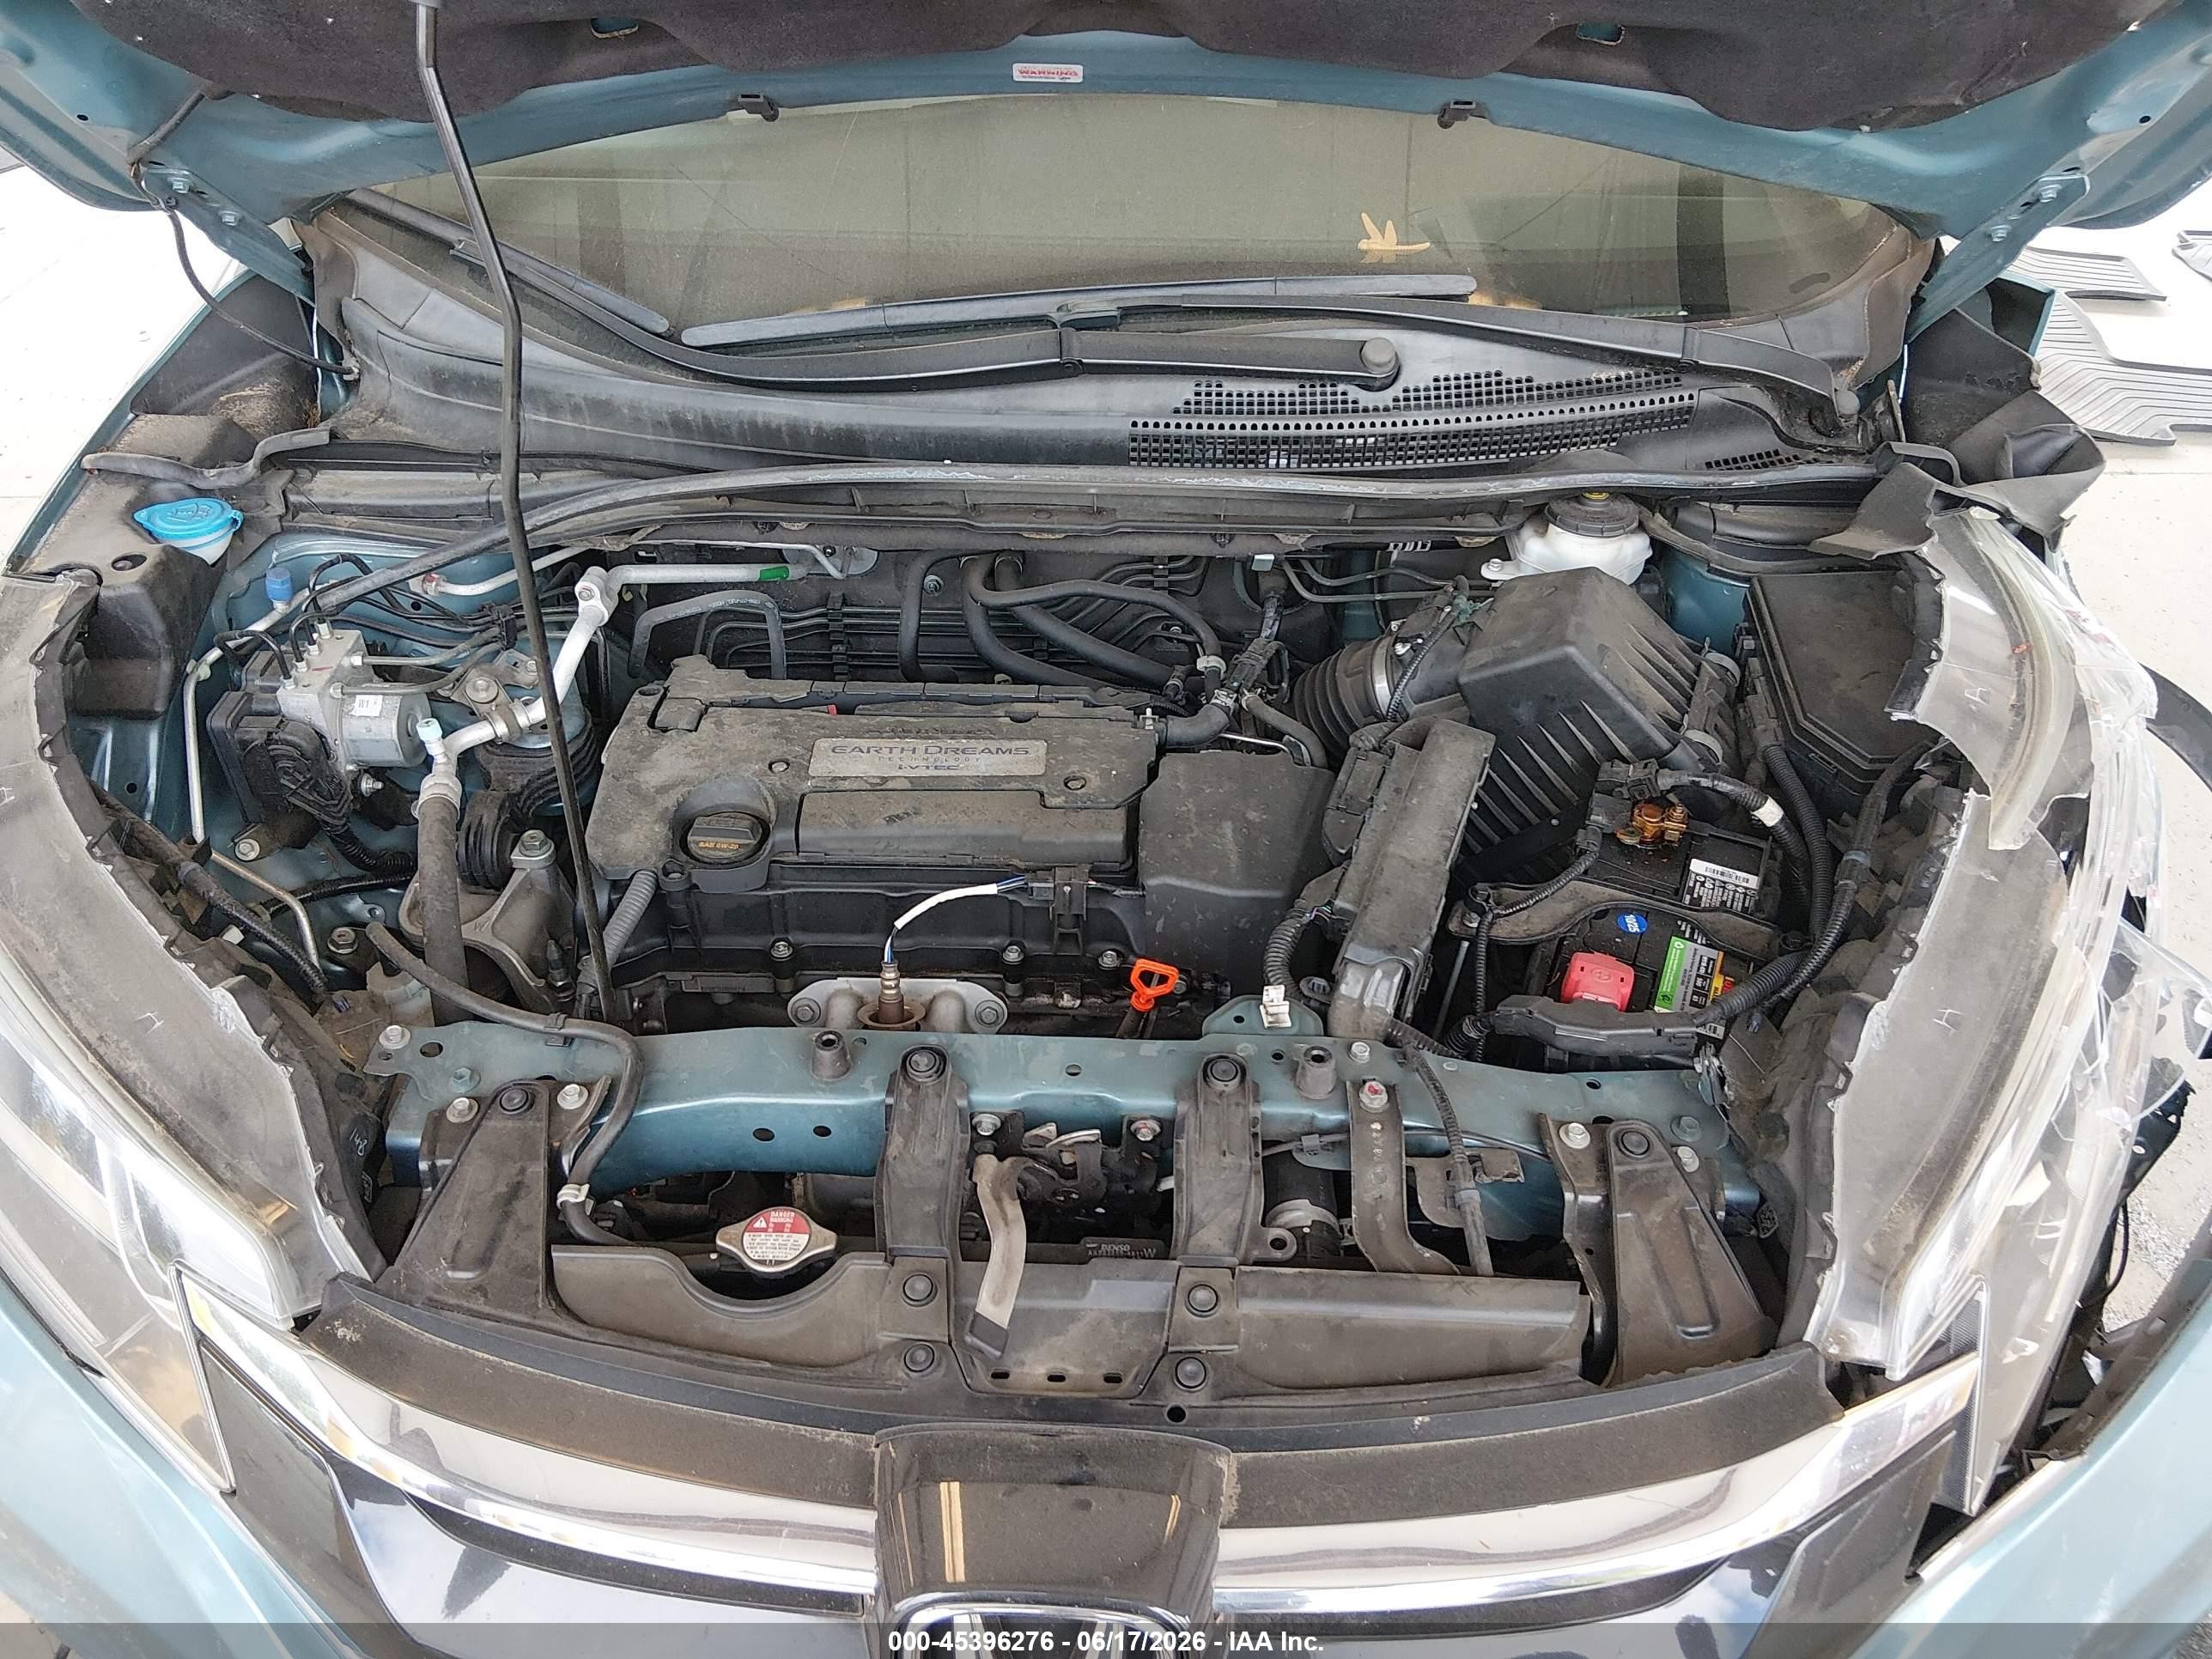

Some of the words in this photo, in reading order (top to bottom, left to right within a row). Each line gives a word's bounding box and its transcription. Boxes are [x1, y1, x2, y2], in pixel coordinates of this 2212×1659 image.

[831, 745, 916, 755] EARTH
[925, 745, 1030, 756] DREAMS
[1624, 914, 1640, 933] 10/25
